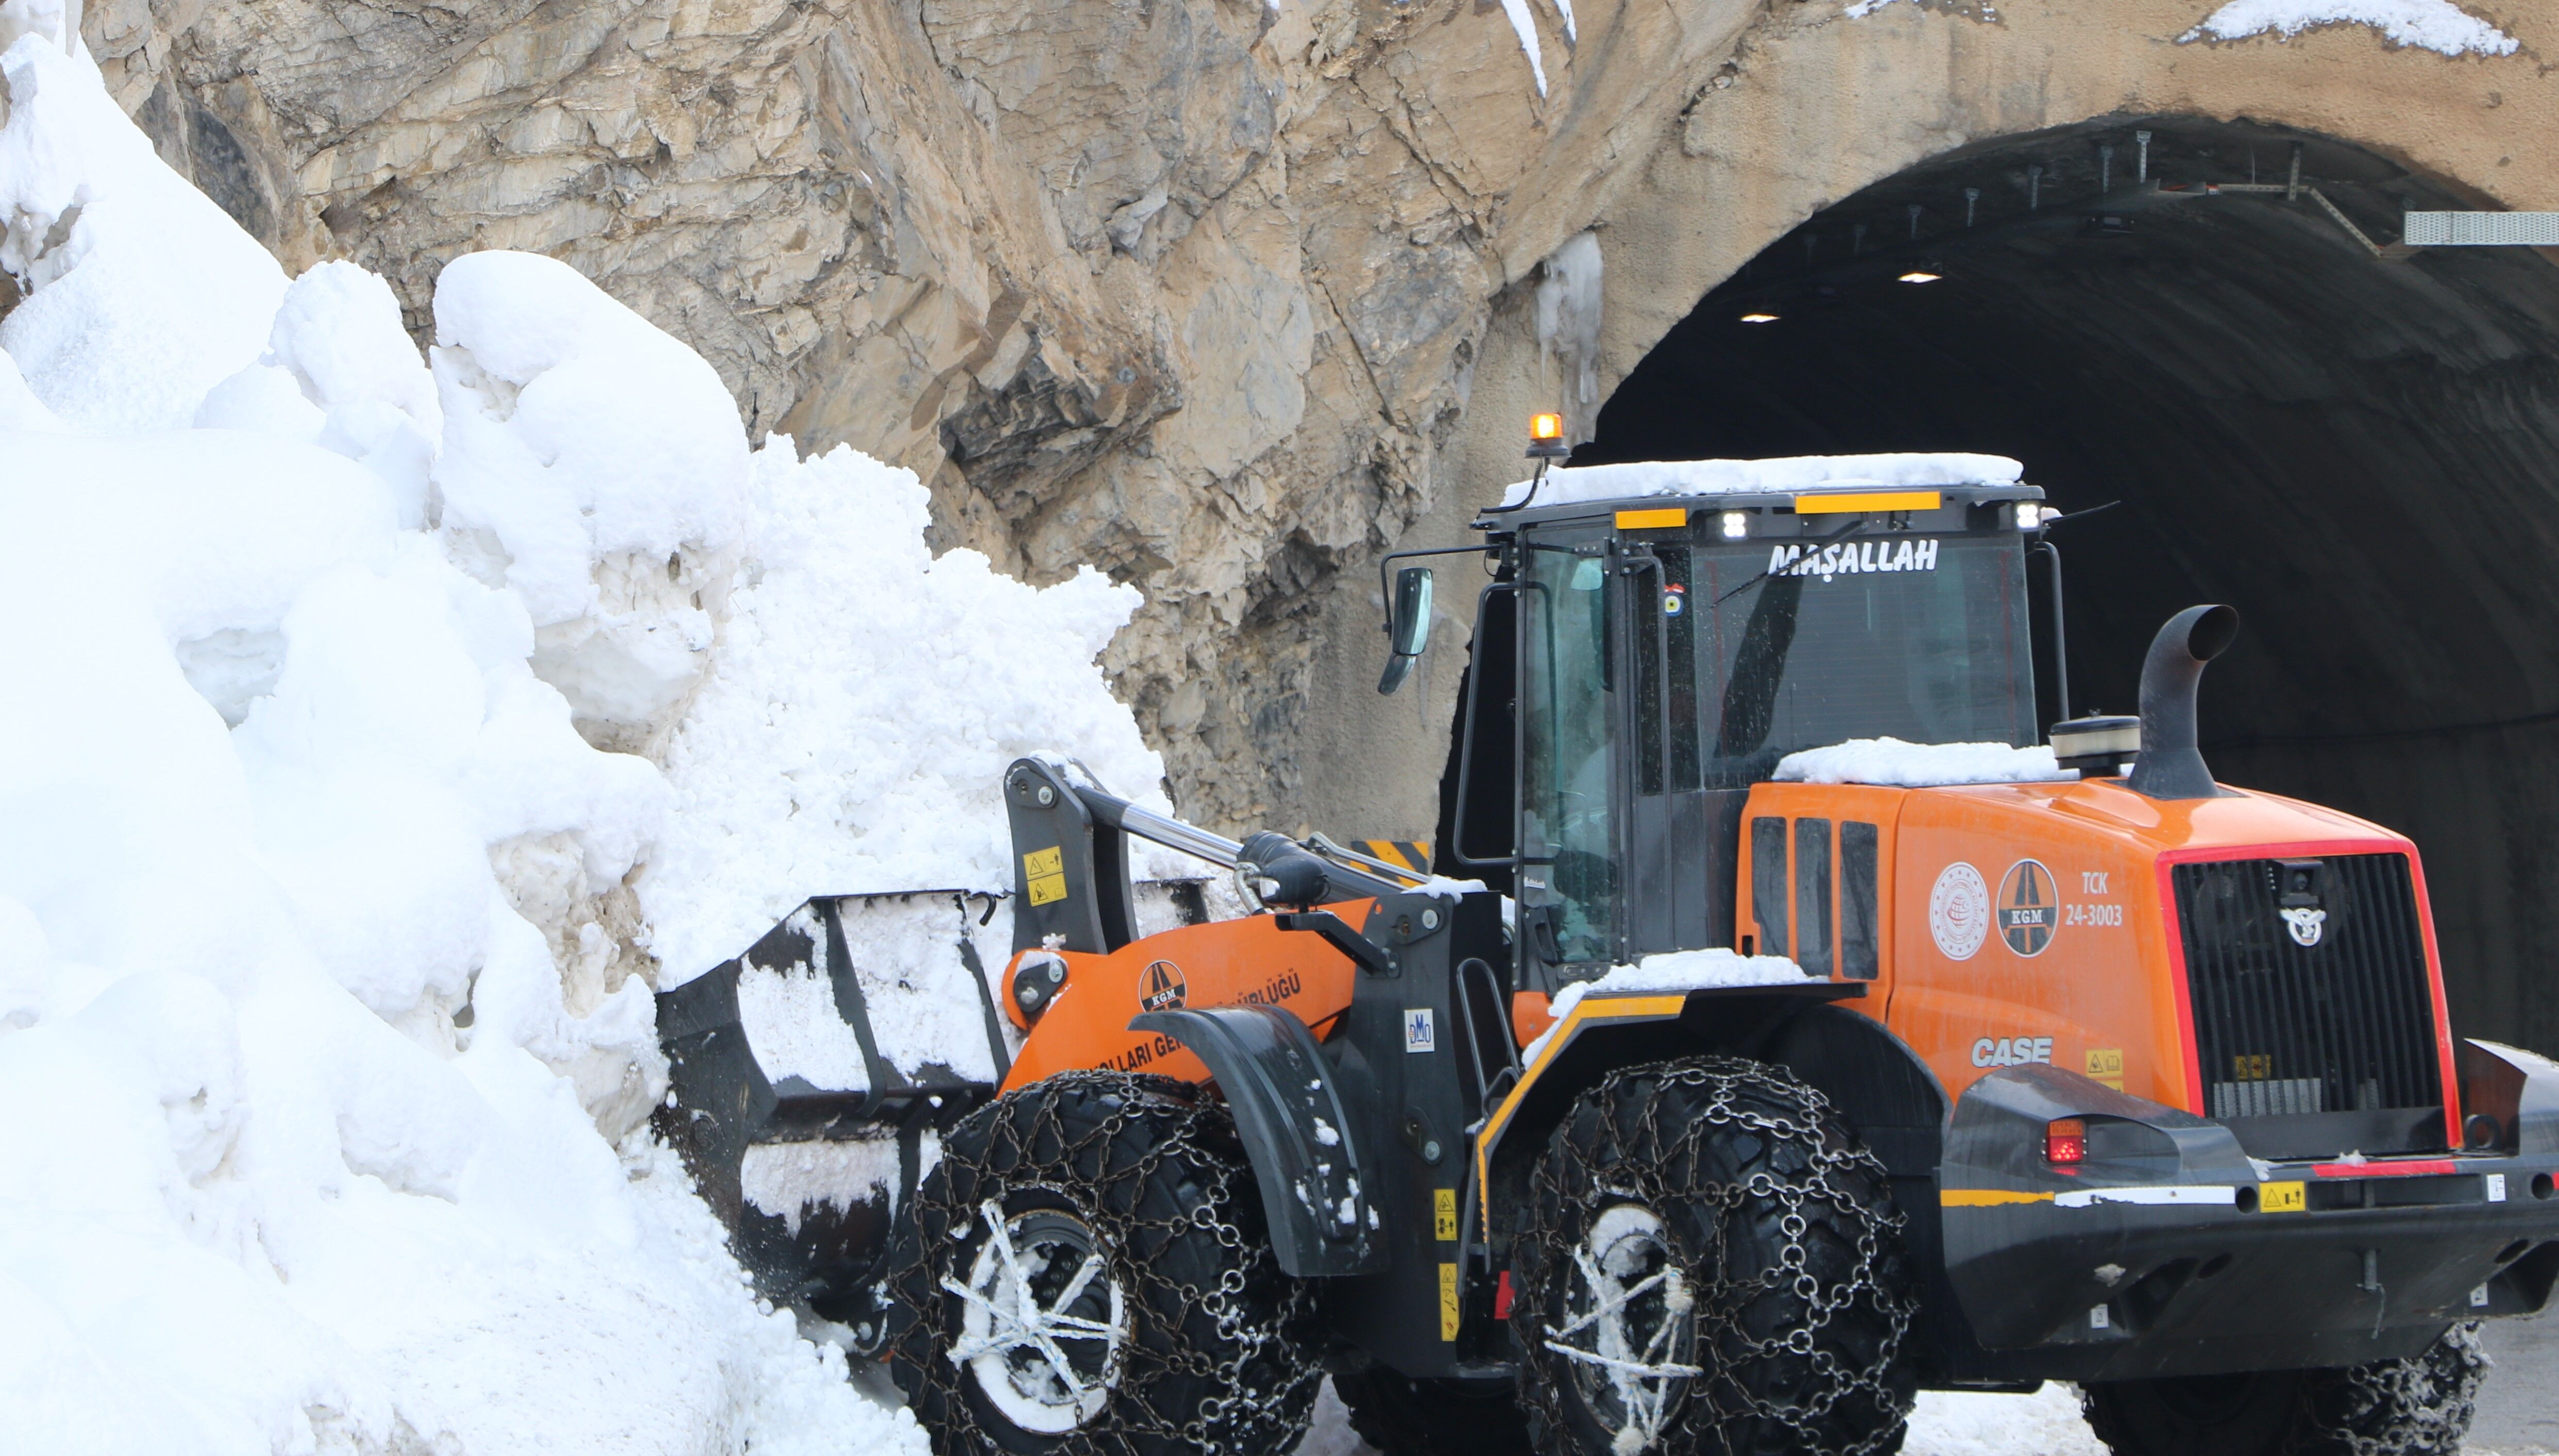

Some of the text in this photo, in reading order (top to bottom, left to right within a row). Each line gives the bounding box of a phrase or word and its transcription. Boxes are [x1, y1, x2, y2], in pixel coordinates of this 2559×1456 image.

[1768, 539, 1939, 583] MAŞALLAH
[2082, 872, 2109, 894] TCK
[2012, 909, 2043, 924] KGM
[2065, 903, 2122, 926] 24-3003
[1151, 989, 1176, 1006] KGM
[1409, 1014, 1431, 1045] DMO
[1972, 1037, 2053, 1068] CASE
